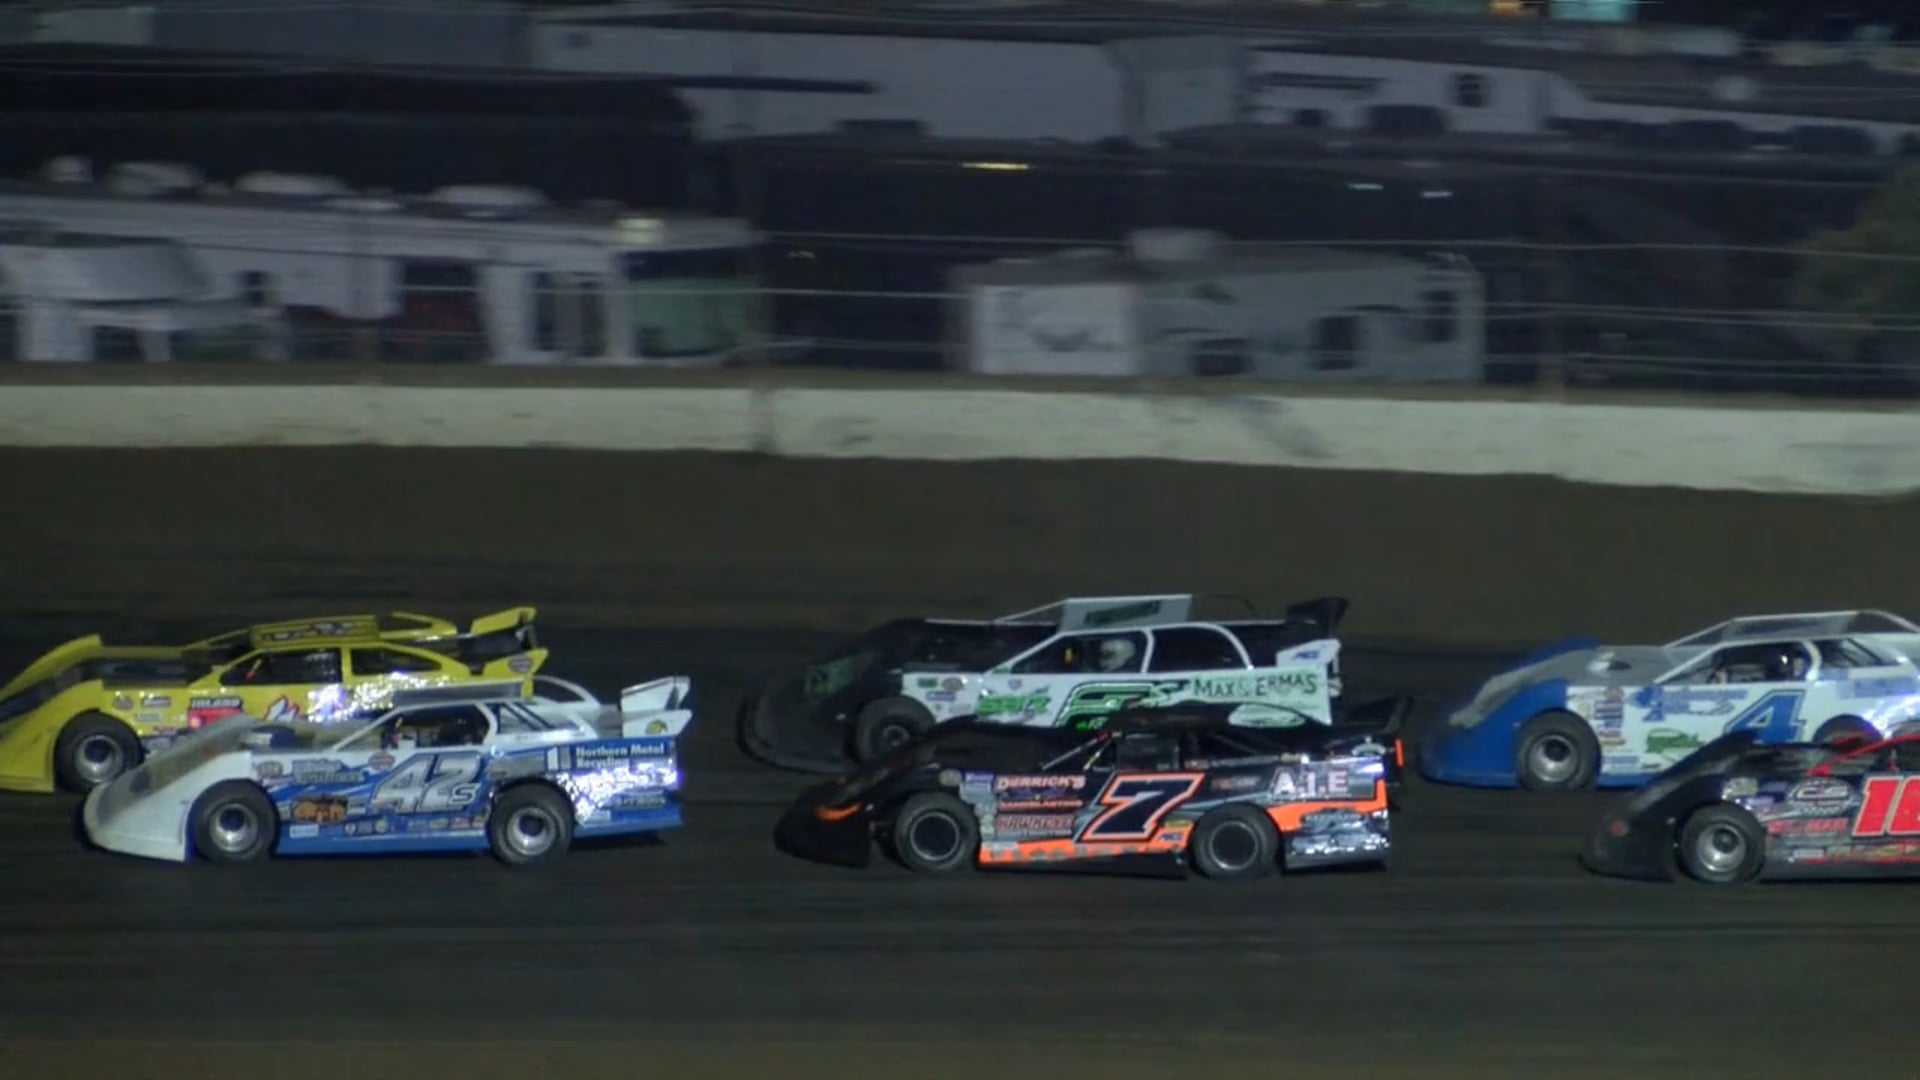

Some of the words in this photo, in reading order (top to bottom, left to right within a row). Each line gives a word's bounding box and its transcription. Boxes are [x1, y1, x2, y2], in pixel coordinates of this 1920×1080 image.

[1193, 679, 1235, 697] MAX
[1256, 674, 1317, 696] ERMAS
[1724, 689, 1806, 744] 4
[576, 745, 629, 757] Northern
[631, 742, 665, 755] Metal
[1080, 772, 1205, 842] 7
